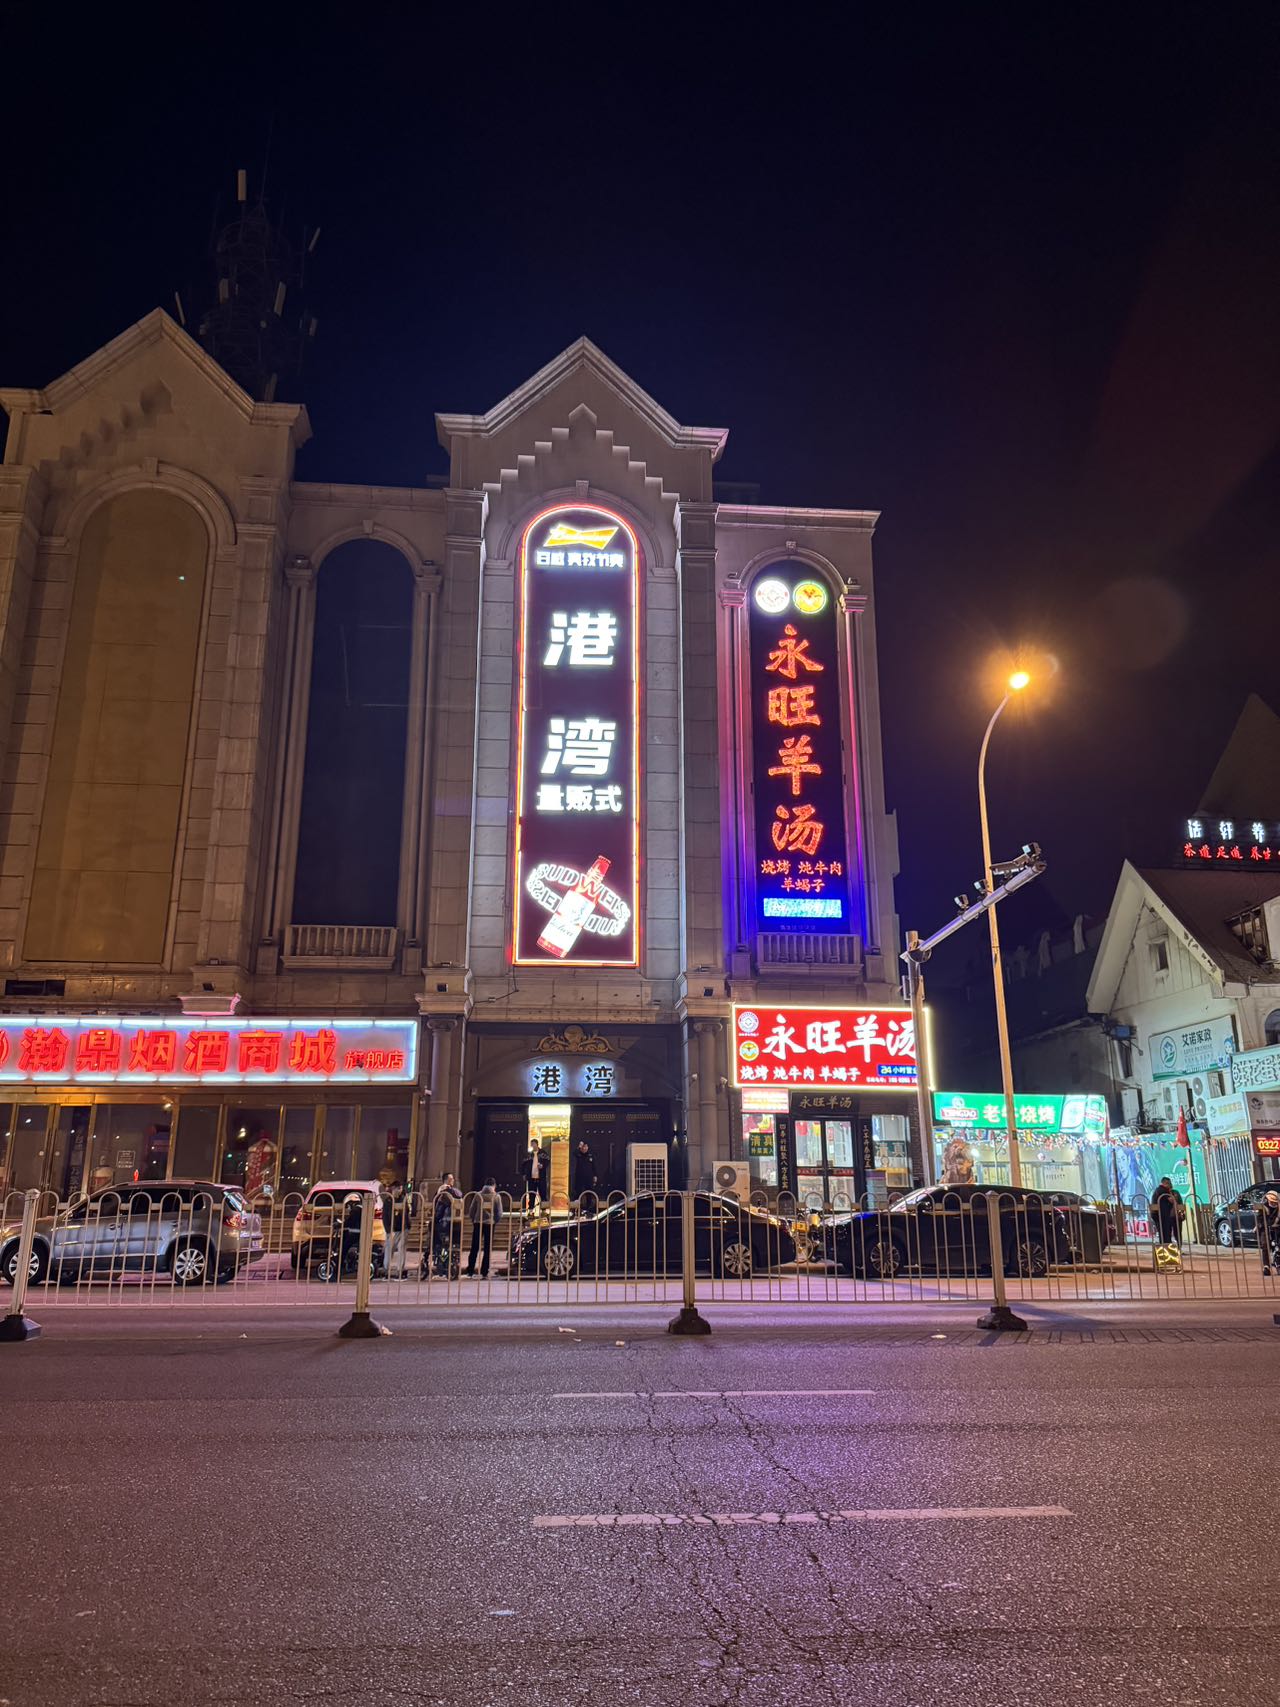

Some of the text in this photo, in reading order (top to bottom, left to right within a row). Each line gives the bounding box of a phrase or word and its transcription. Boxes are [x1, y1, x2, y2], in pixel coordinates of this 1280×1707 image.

[541, 612, 617, 774] 港湾
[765, 623, 824, 855] 永旺羊汤
[536, 784, 622, 813] 量贩式
[761, 859, 843, 876] 烧烤 炖牛肉
[781, 877, 826, 893] 羊蝎子
[761, 1013, 917, 1063] 永旺羊汤
[18, 1026, 404, 1074] 瀚鼎烟酒商城 旗舰店
[533, 1065, 613, 1095] 港湾
[740, 1065, 769, 1081] 烧烤
[773, 1065, 815, 1081] 炖牛肉
[819, 1065, 861, 1082] 羊蝎子
[799, 1095, 853, 1109] 永旺羊汤
[751, 1135, 774, 1147] 清真
[1258, 1140, 1279, 1149] 0322
